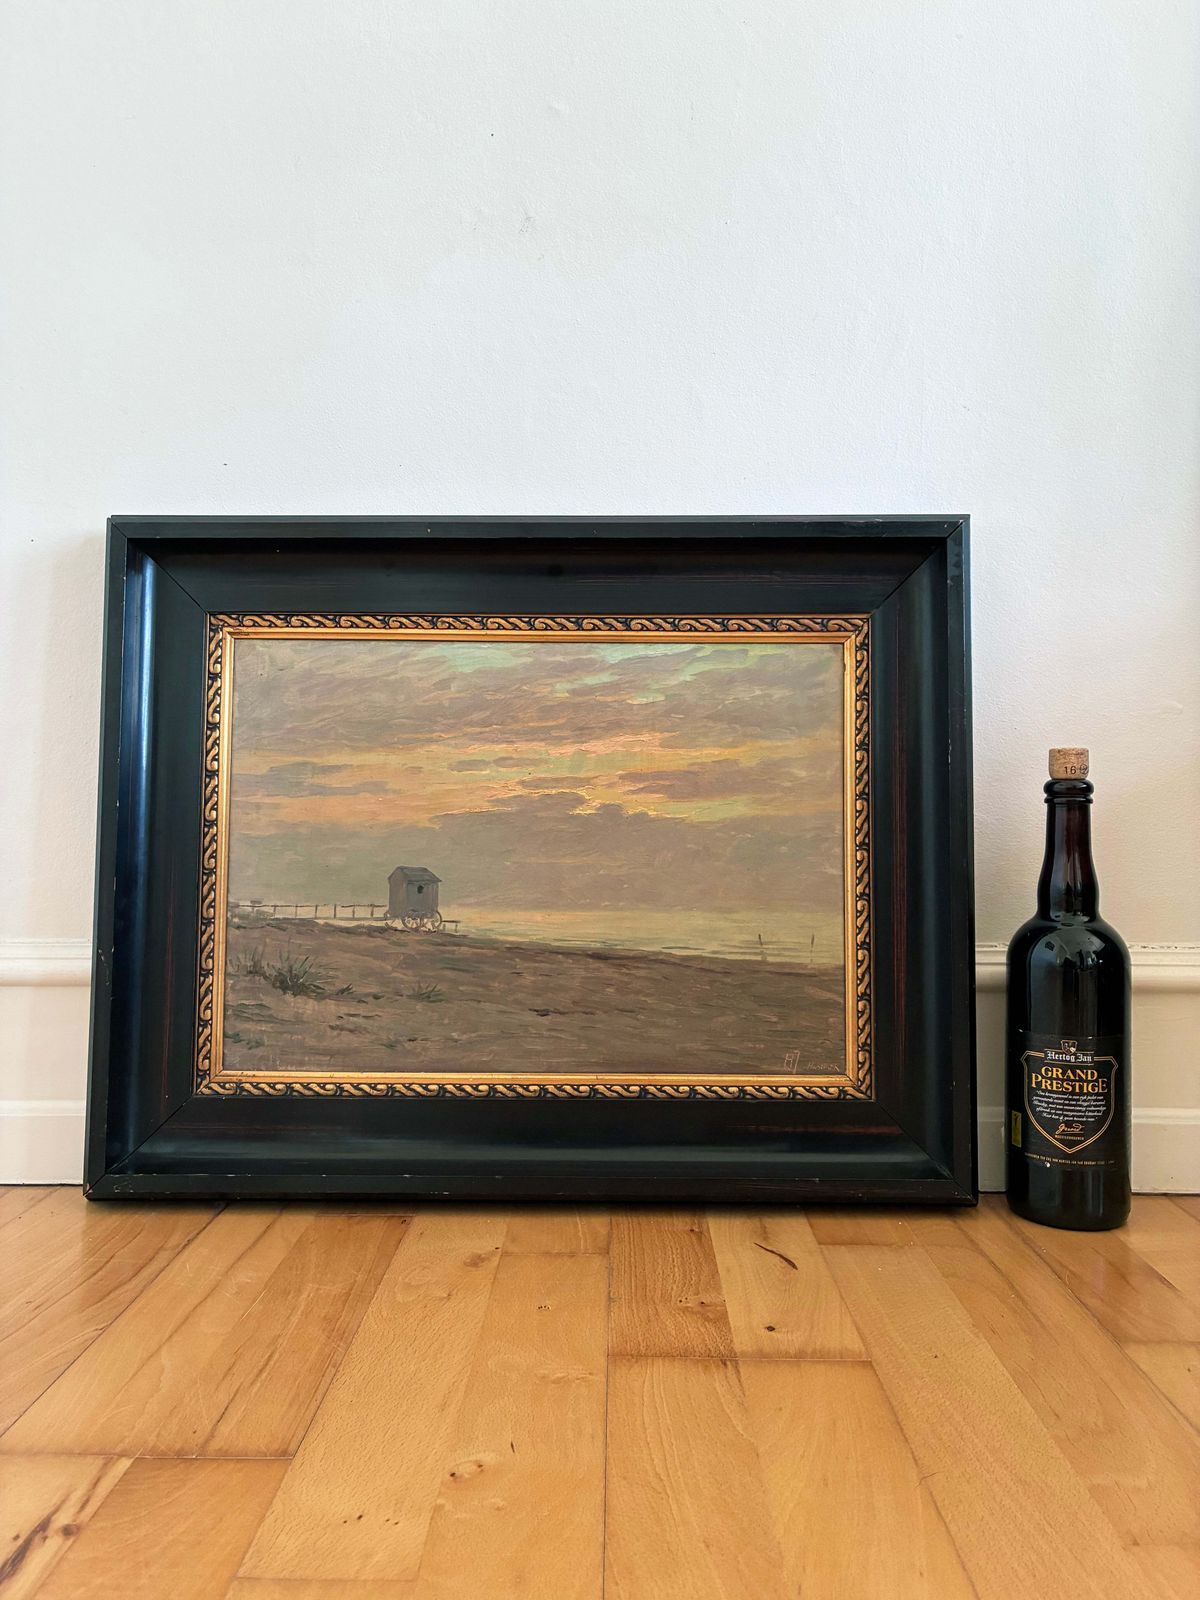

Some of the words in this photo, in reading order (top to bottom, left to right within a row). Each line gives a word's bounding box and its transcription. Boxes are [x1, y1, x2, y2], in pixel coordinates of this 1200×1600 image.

[1064, 765, 1077, 775] 16
[1046, 1050, 1075, 1063] Hertog
[1076, 1053, 1092, 1063] Jan
[1041, 1065, 1098, 1081] GRAND
[1031, 1072, 1108, 1094] PRESTIGE
